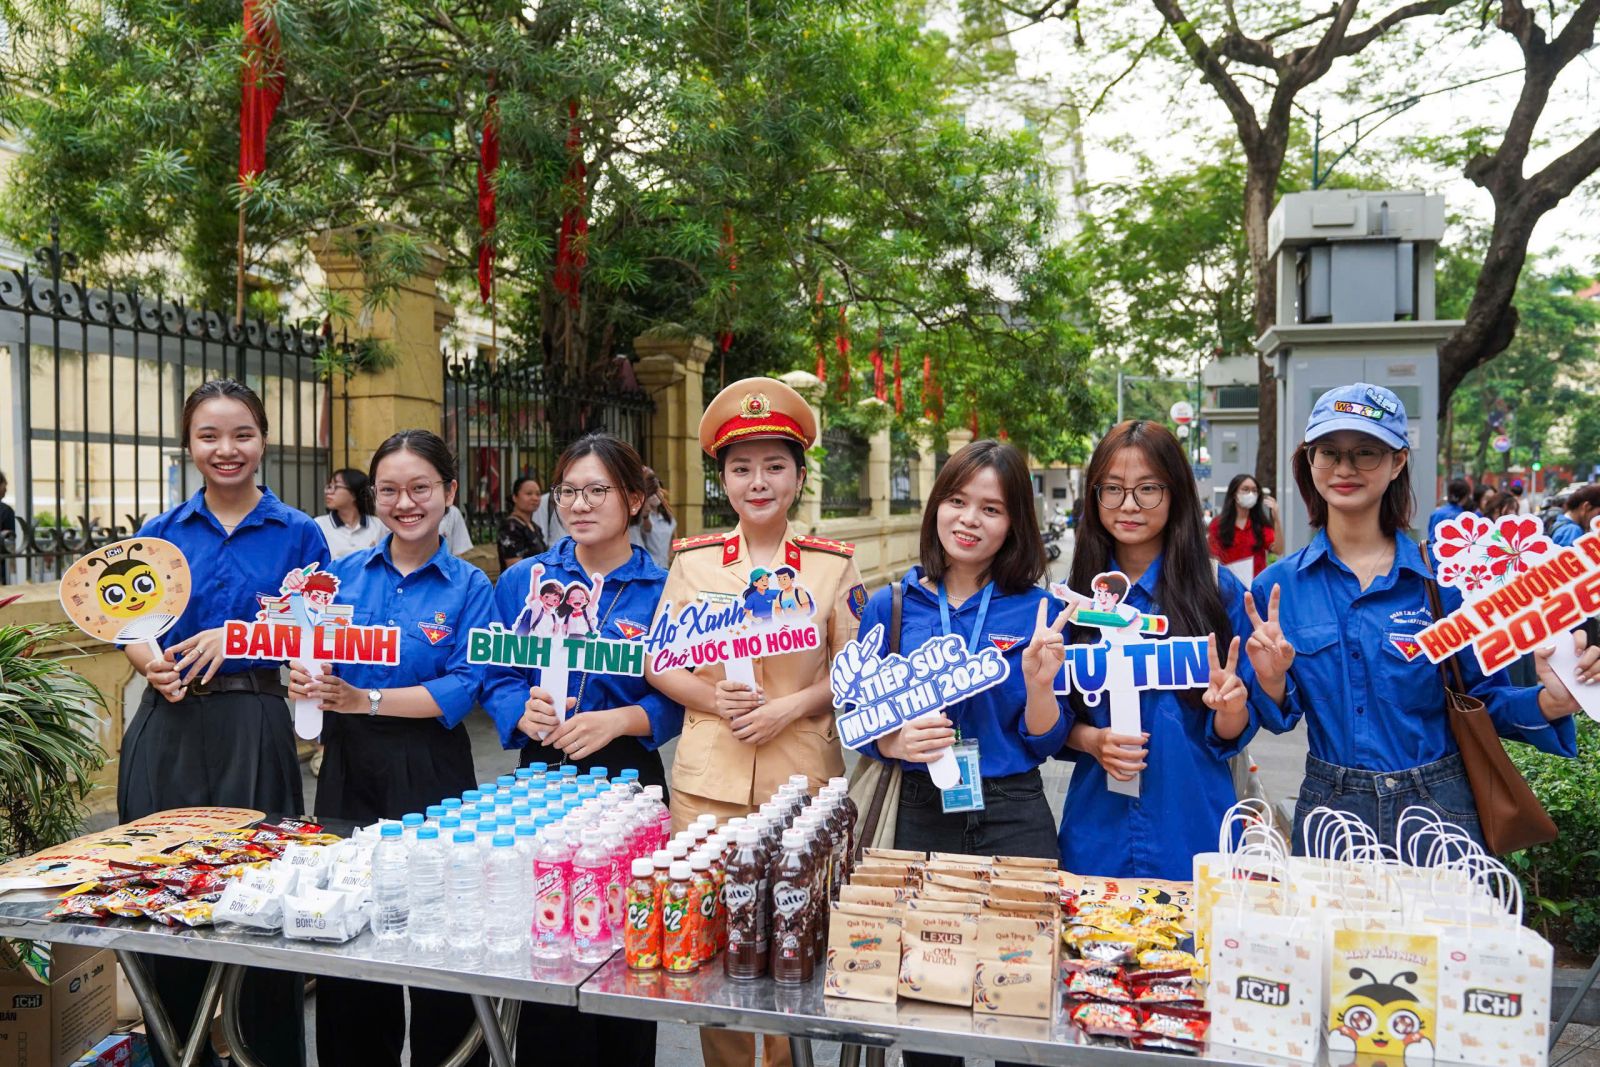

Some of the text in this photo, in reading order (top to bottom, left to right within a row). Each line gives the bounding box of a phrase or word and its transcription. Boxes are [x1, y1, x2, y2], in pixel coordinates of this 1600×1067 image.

[644, 600, 747, 653] Áo Xanh
[1419, 613, 1481, 660] HOA
[1473, 551, 1587, 627] PHƯỢNG
[1477, 572, 1600, 672] 2026
[226, 612, 301, 657] BẢN
[470, 626, 643, 674] BÌNH TĨNH
[654, 649, 690, 672] Chở
[733, 634, 761, 658] MƠ
[766, 624, 817, 653] HỒNG
[860, 639, 961, 701] TIẾP SỨC
[1123, 641, 1209, 687] TIN
[841, 652, 1000, 741] MÙA THI 2026
[628, 904, 649, 929] C2
[663, 905, 683, 931] C2
[776, 894, 806, 906] Latte
[922, 931, 960, 944] LEXUS
[923, 951, 956, 966] krunch
